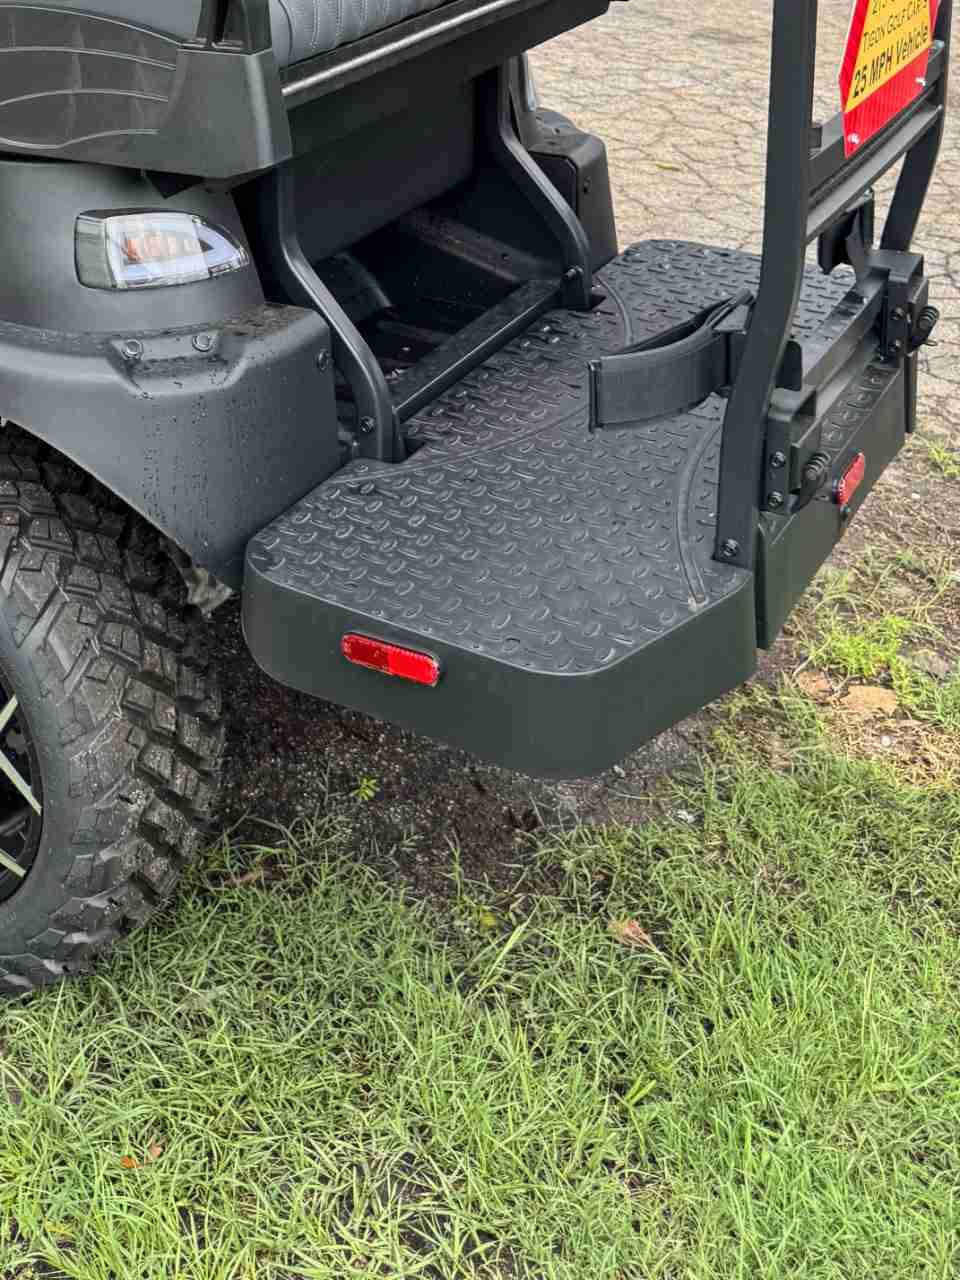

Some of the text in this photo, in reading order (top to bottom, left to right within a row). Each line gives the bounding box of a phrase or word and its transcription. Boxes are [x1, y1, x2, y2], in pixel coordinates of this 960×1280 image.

[853, 21, 929, 98] 25 MPH Vehicle
[863, 24, 885, 52] TIGON
[887, 8, 906, 34] GOLF
